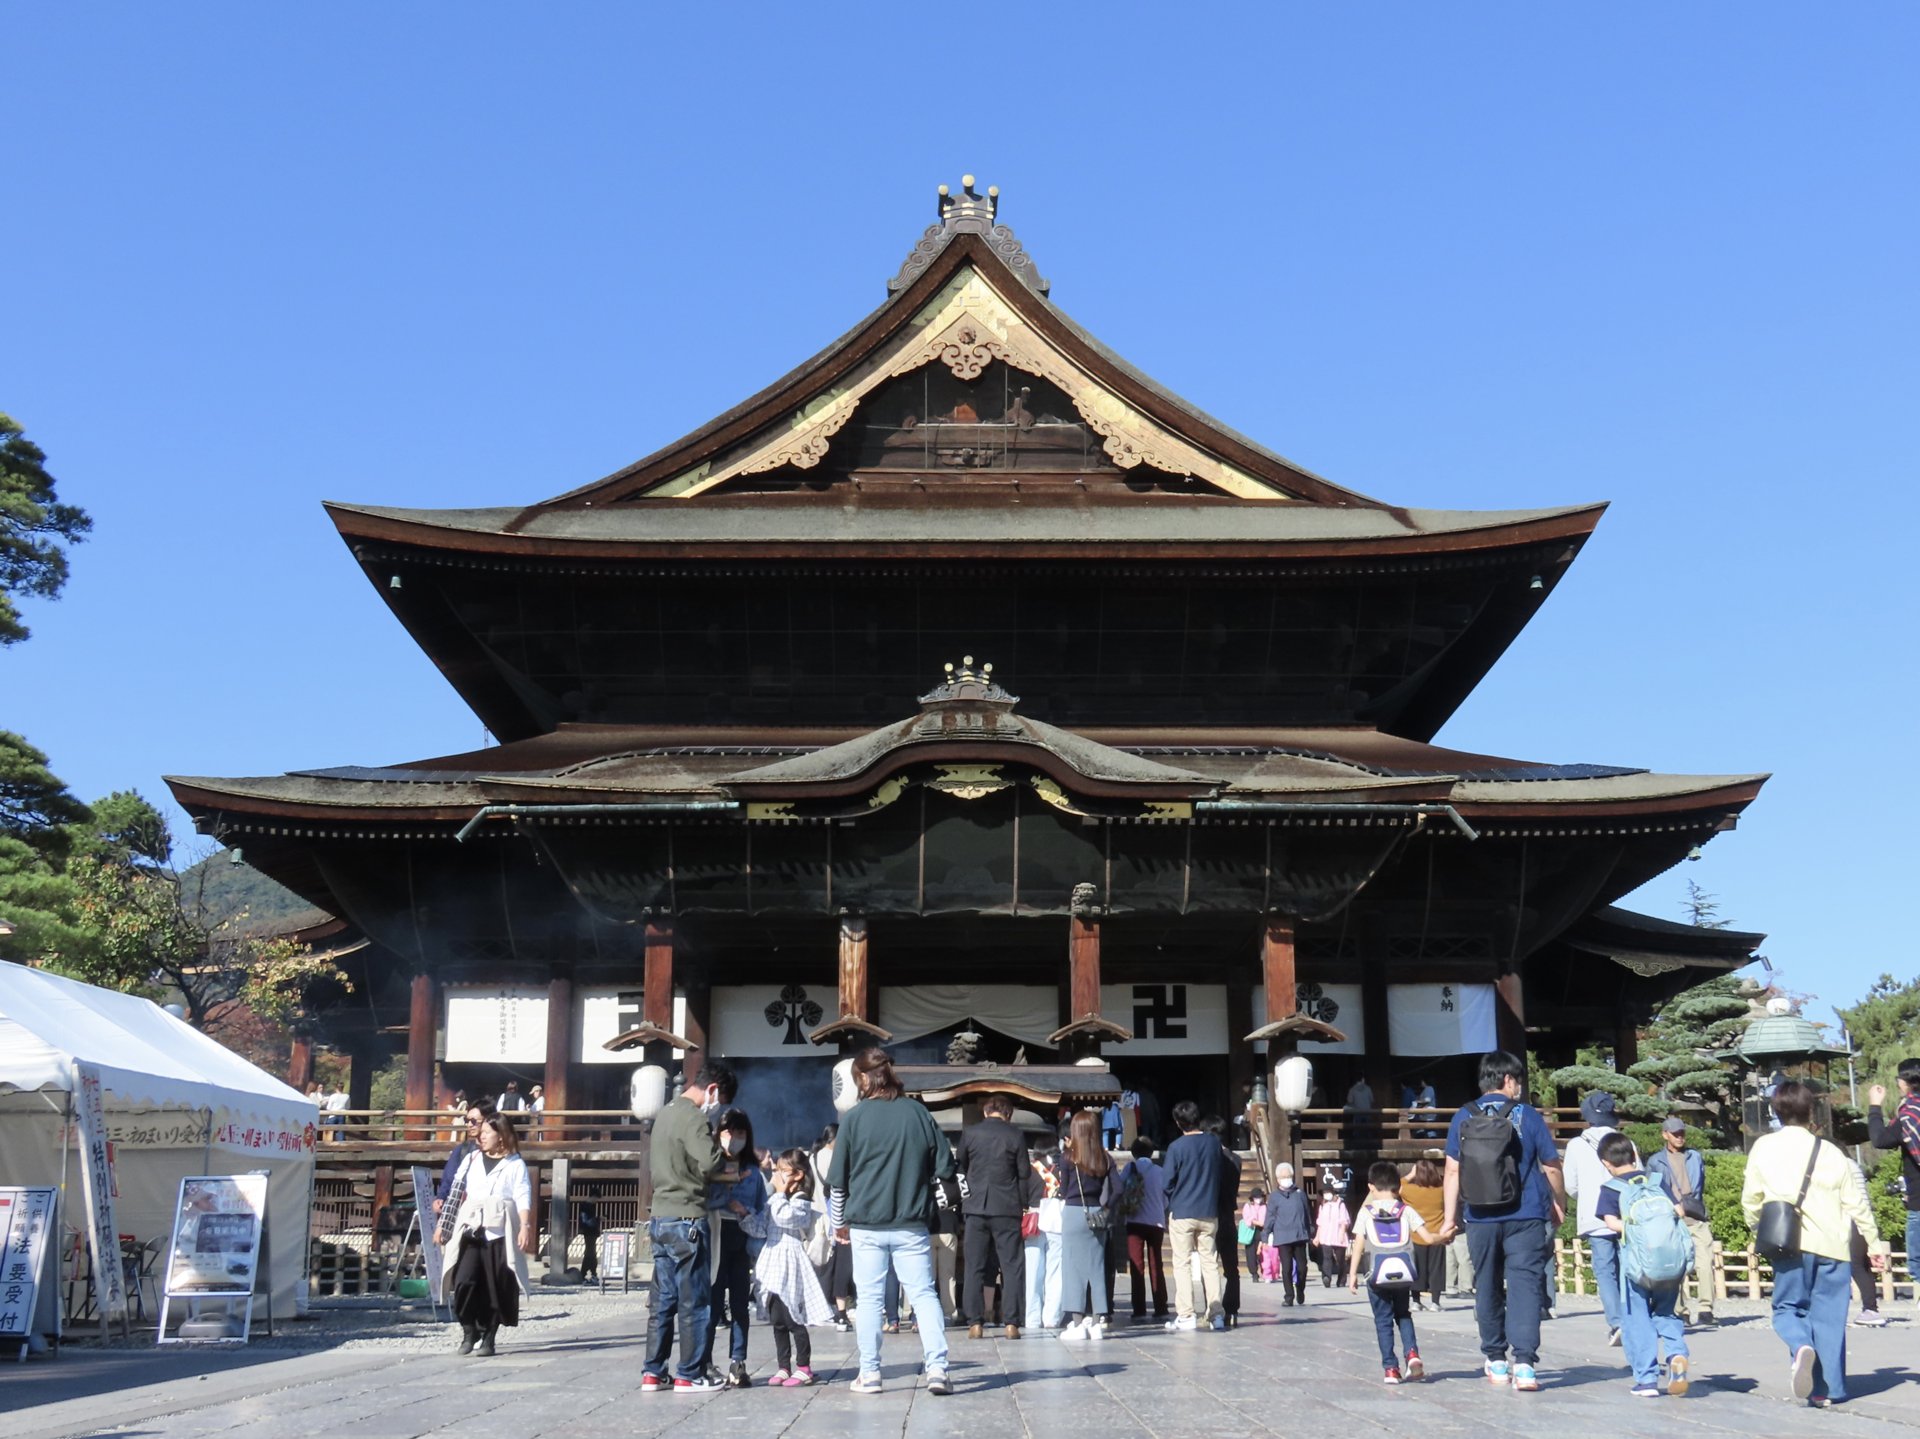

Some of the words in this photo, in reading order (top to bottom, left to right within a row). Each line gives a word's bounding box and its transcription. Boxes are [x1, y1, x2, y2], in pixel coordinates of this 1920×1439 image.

[106, 1125, 211, 1144] 三・初まいり受付
